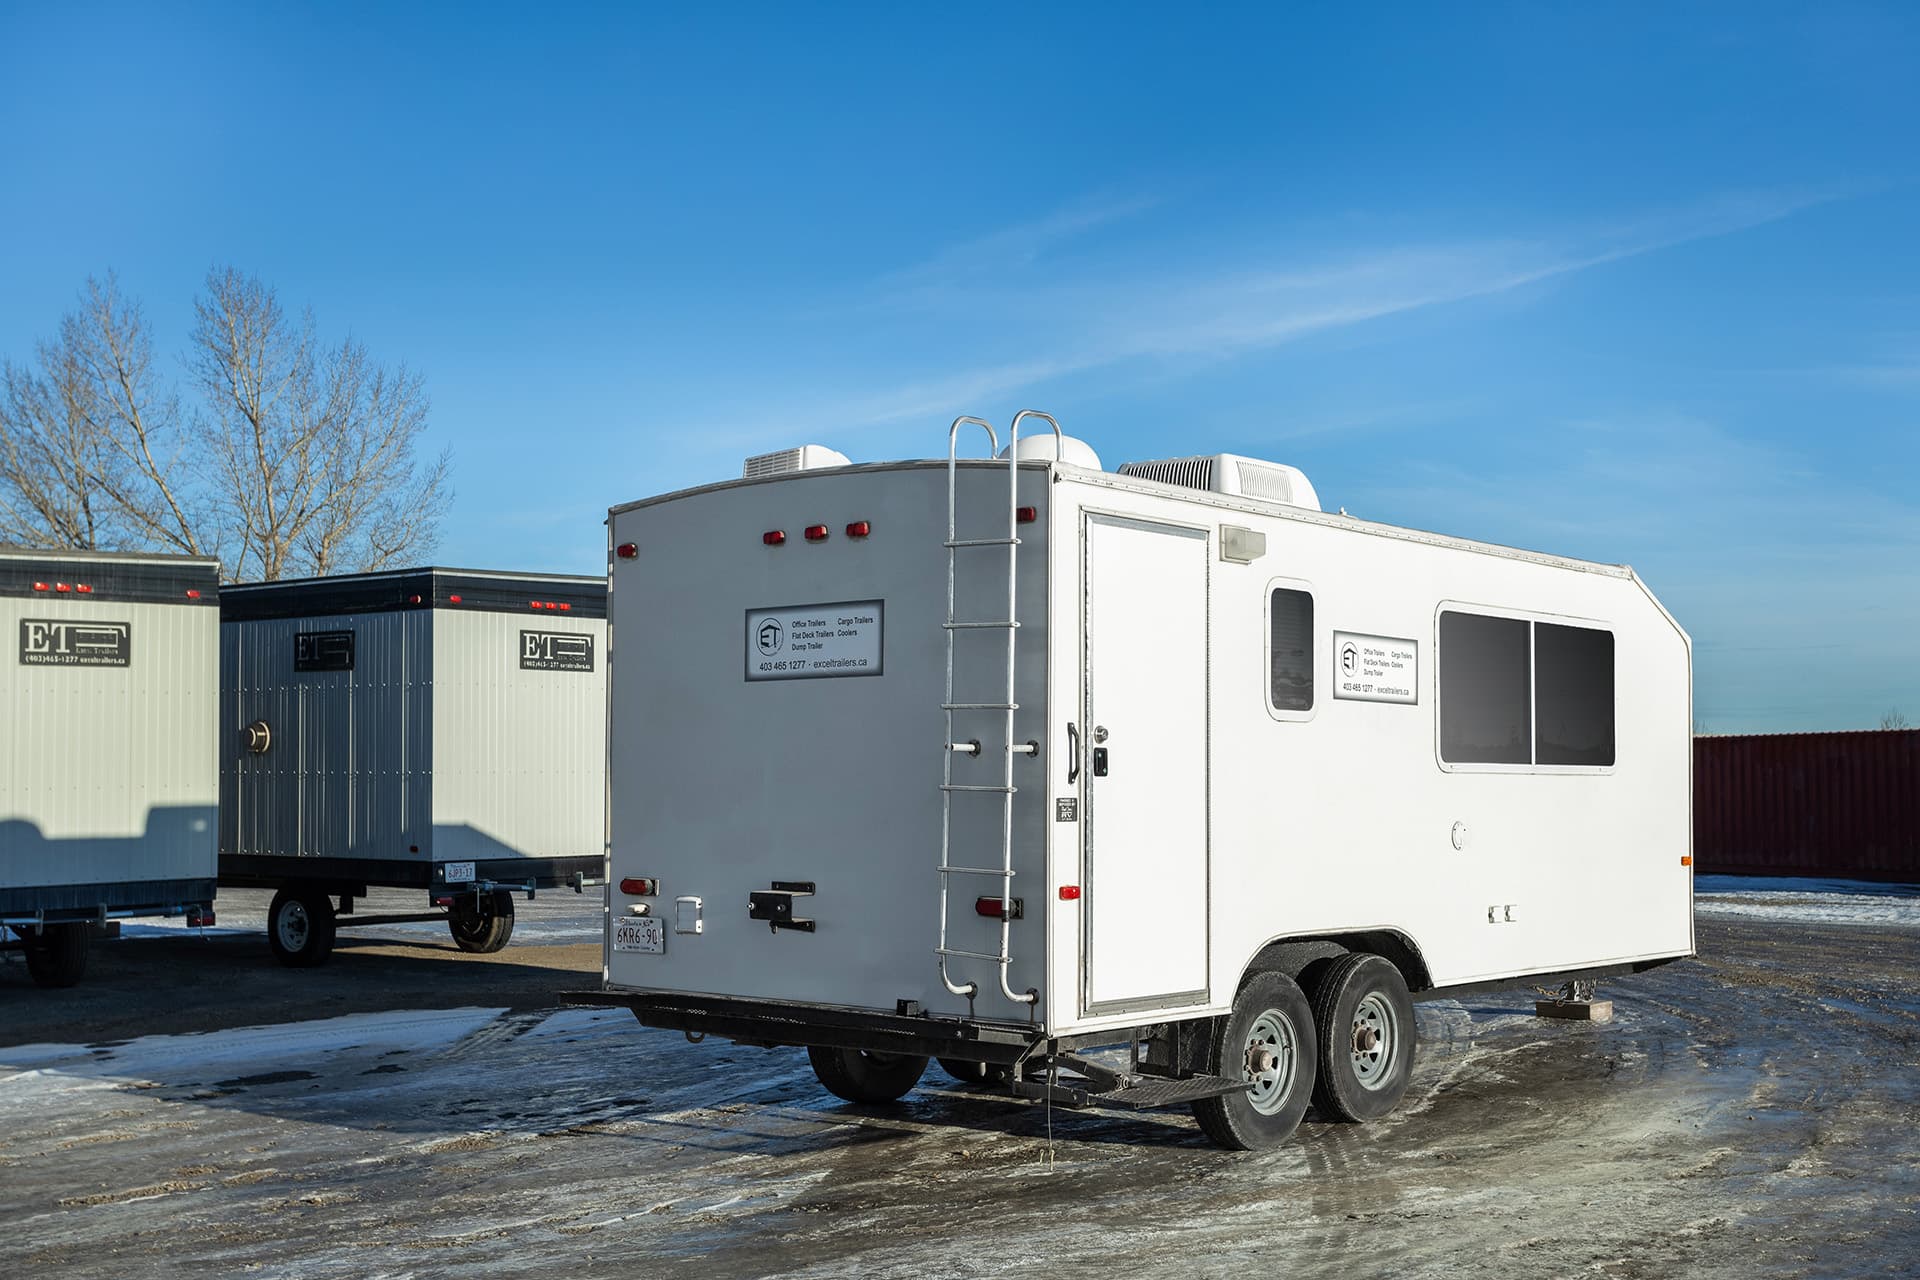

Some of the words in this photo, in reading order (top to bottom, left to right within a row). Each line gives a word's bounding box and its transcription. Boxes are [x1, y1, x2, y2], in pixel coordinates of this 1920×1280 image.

[791, 621, 807, 629] Office
[808, 619, 826, 627] Trailers
[837, 617, 853, 626] Cargo
[854, 616, 873, 624] Trailers
[791, 632, 802, 640] Flat
[802, 631, 815, 639] Deck
[816, 630, 834, 638] Trailers
[837, 629, 858, 637] Coolers
[791, 643, 807, 651] Dump
[808, 642, 823, 650] Trailer
[760, 662, 773, 671] 403
[774, 661, 787, 670] 465
[789, 660, 806, 670] 1277
[813, 658, 868, 669] exceltrailers.ca
[1343, 683, 1352, 691] 403
[1362, 684, 1373, 692] 1277
[617, 927, 658, 945] 6KR6-90
